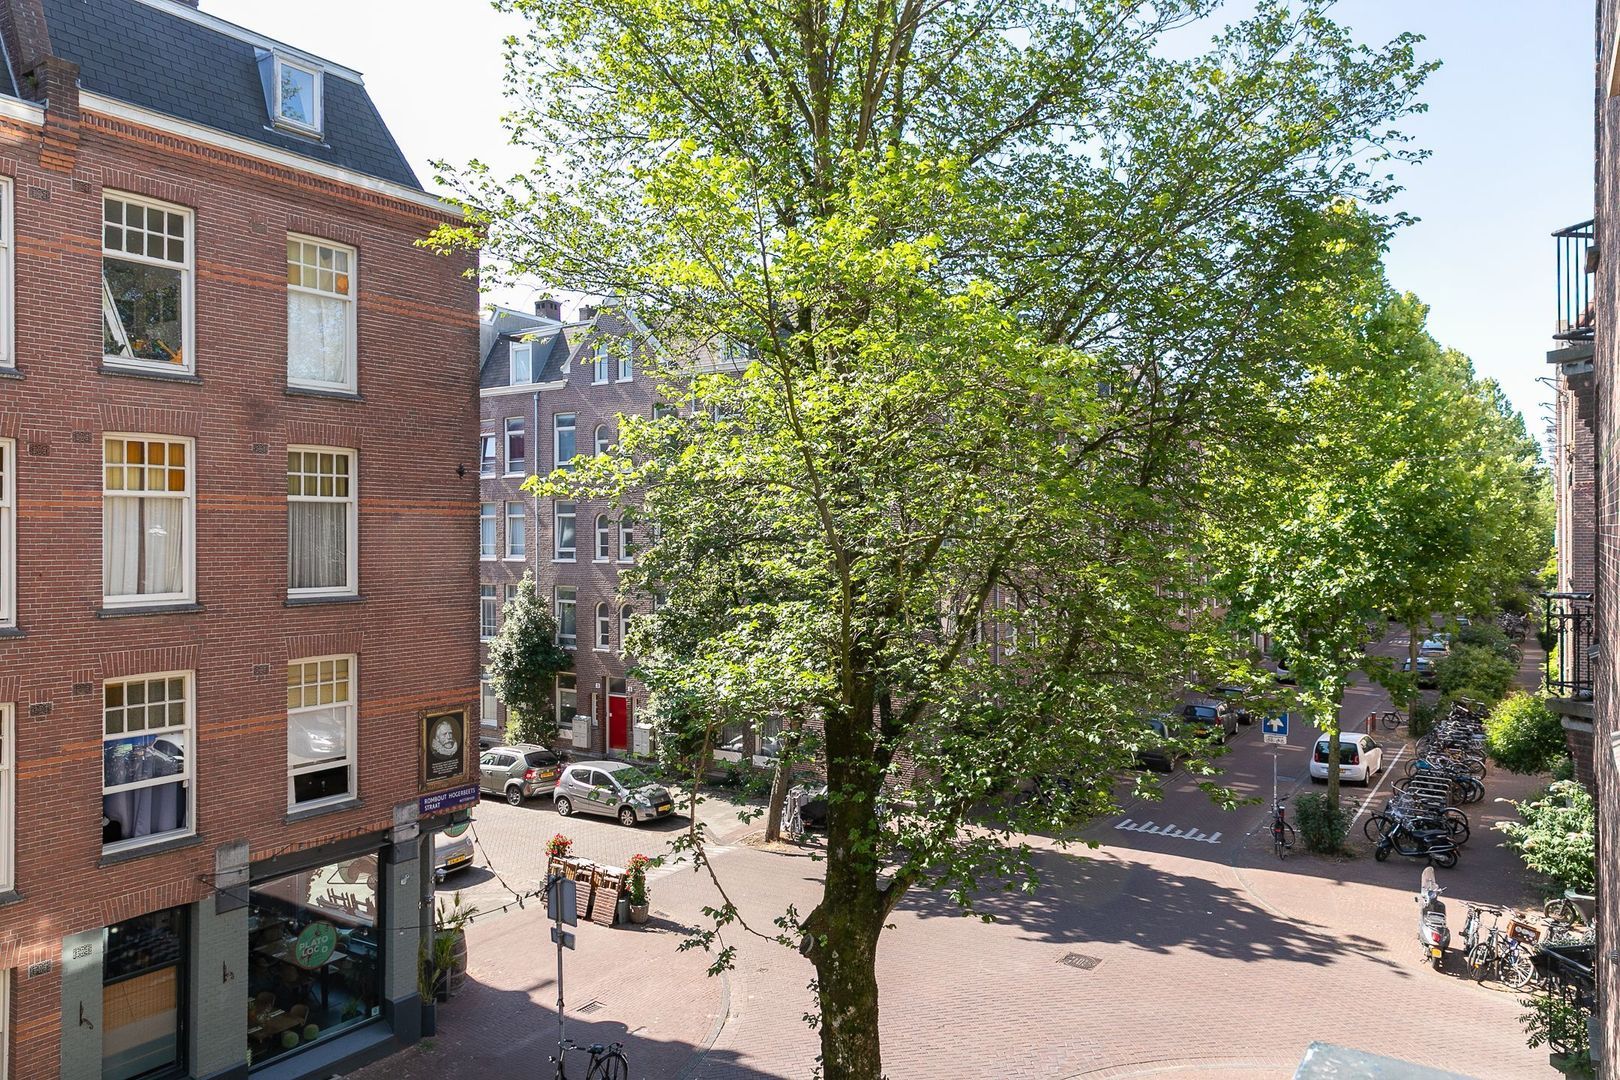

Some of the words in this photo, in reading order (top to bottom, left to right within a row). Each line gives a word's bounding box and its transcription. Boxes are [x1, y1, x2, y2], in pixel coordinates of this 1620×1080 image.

[424, 794, 447, 804] ROMBOUT
[448, 788, 476, 798] HOGERBEETS
[424, 802, 440, 811] STRAAT
[299, 935, 328, 950] PLATO
